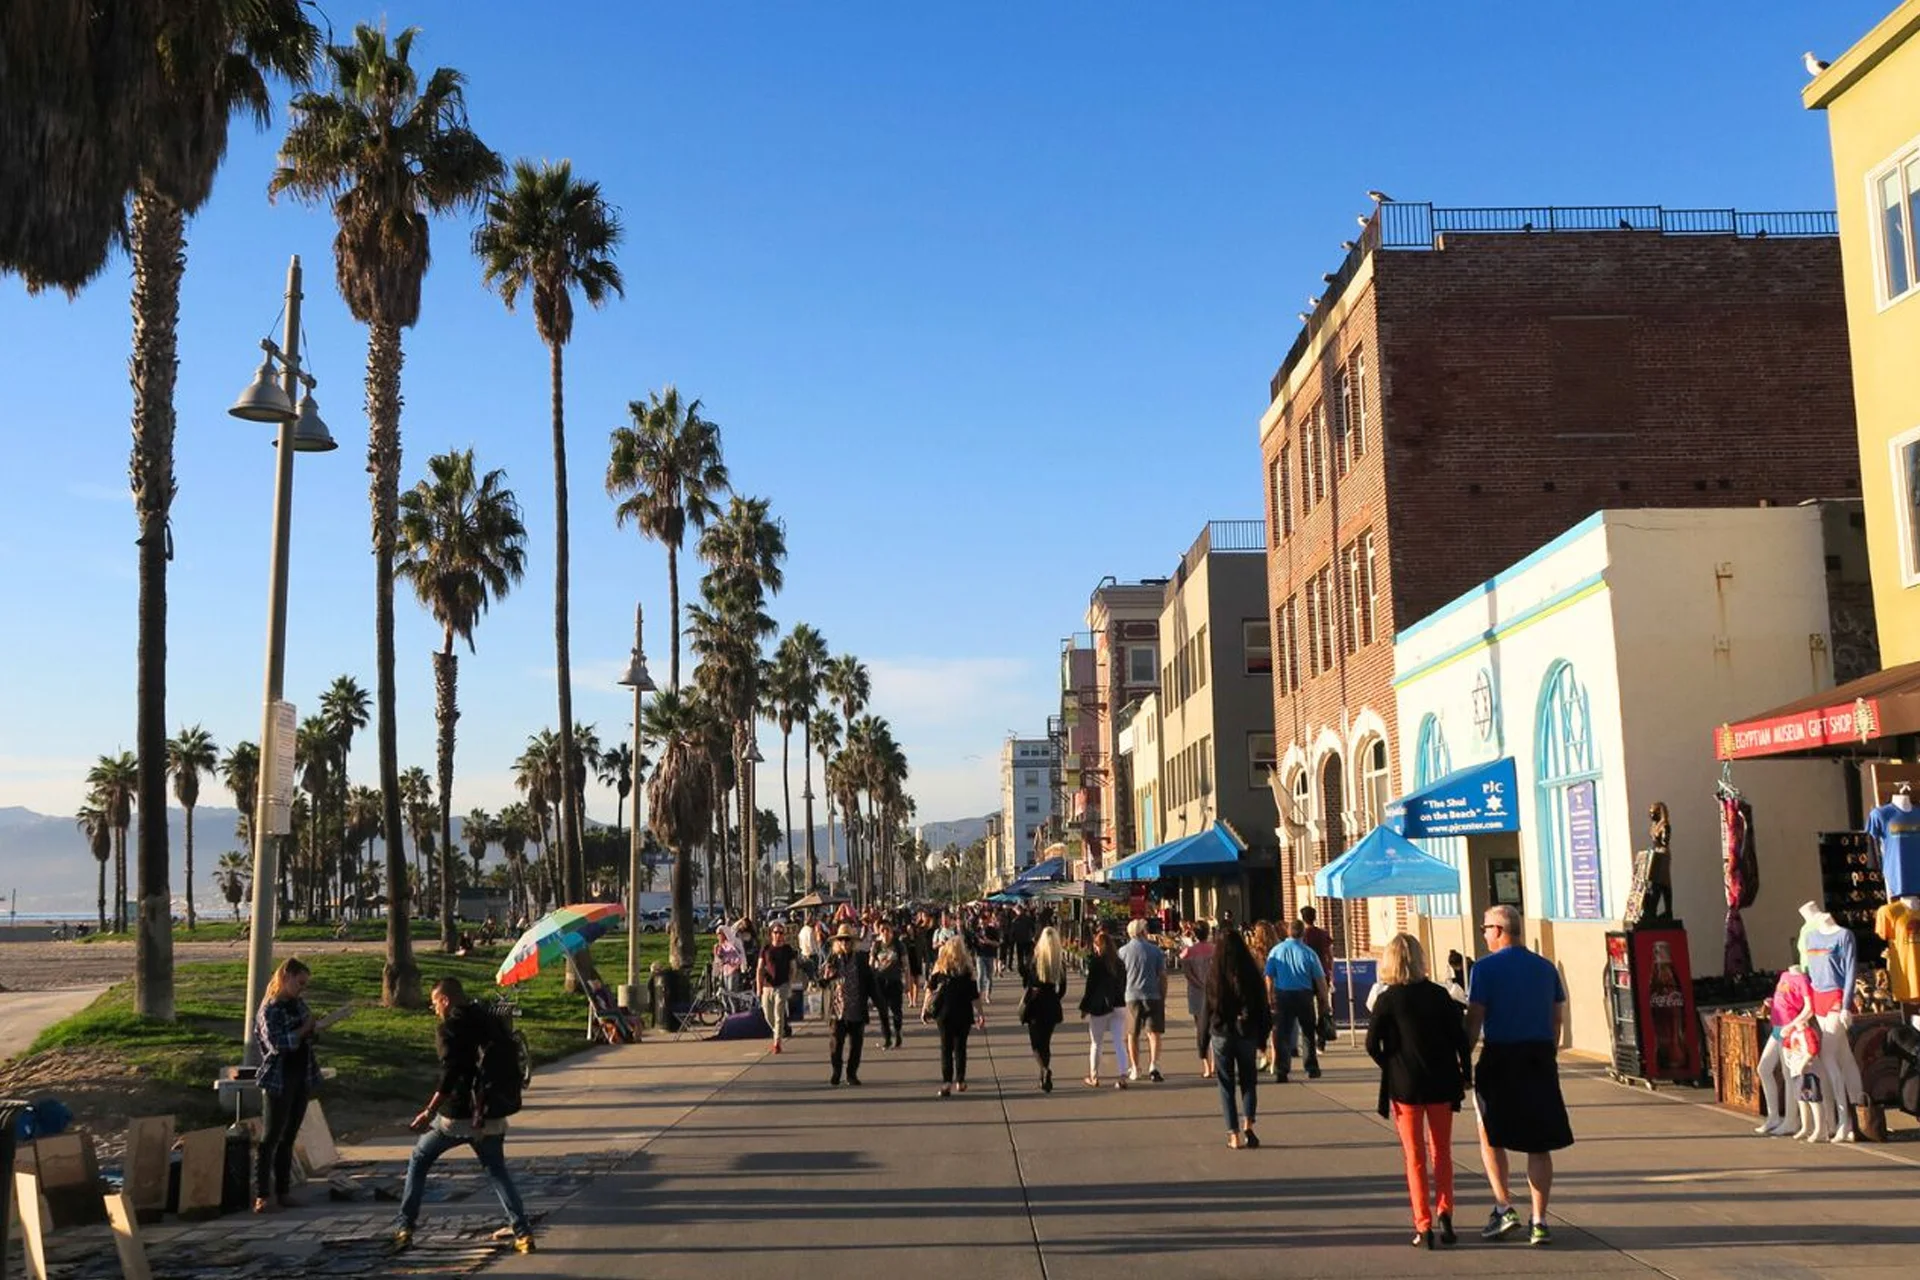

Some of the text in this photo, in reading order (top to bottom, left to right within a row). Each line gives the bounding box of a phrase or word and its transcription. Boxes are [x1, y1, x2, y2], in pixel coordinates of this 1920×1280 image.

[1734, 714, 1852, 749] EGYPTIAN MUSEUM GIFT SHOP
[1433, 811, 1448, 820] the
